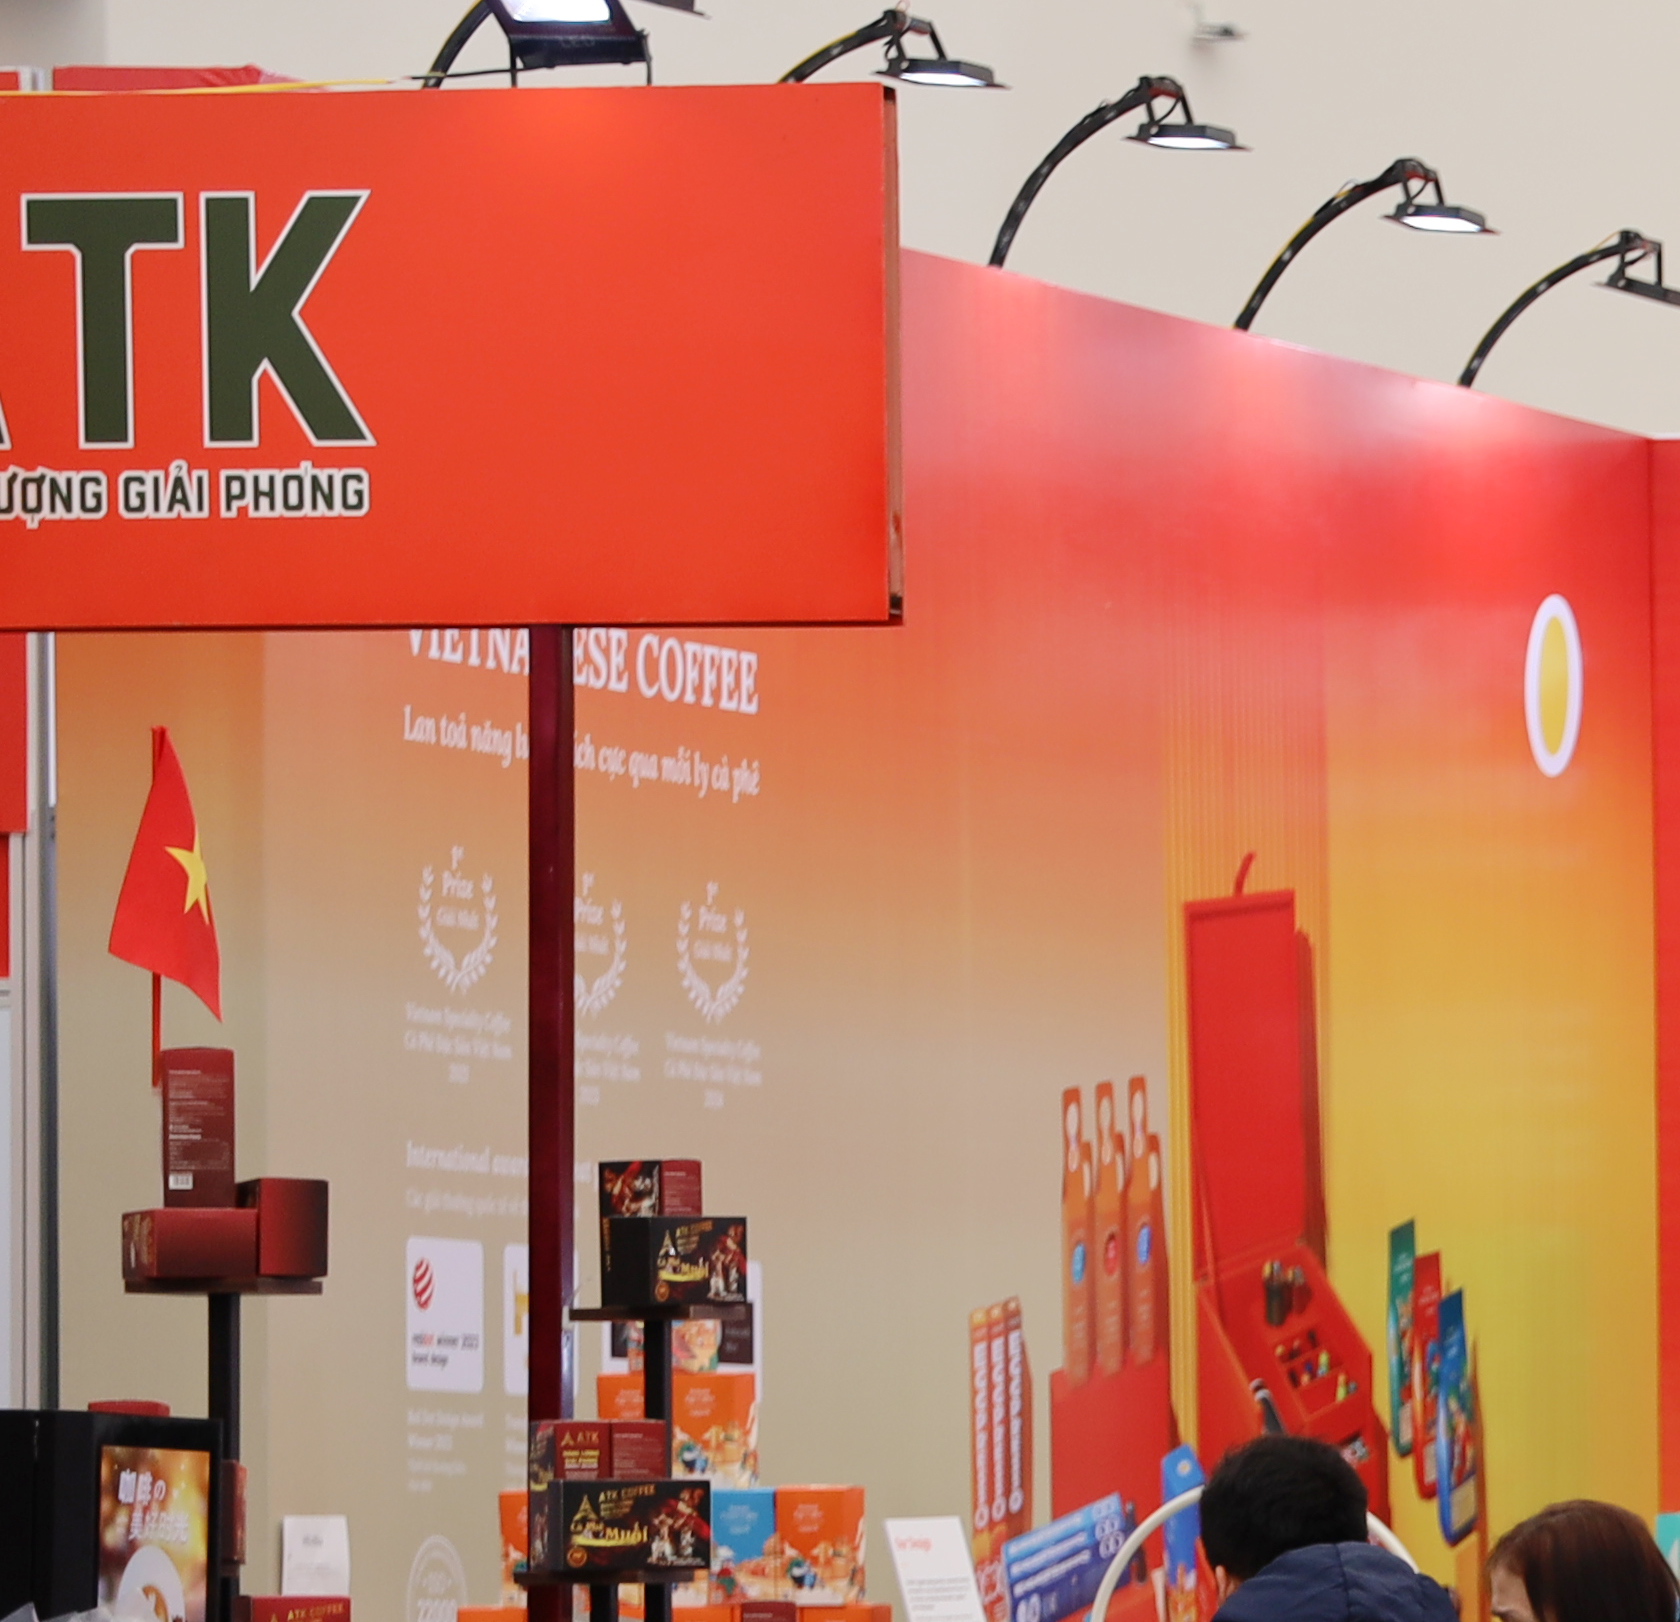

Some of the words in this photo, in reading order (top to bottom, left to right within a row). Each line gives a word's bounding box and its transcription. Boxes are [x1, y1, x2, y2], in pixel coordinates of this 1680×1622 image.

[0, 188, 376, 449] TK
[118, 459, 209, 518] GIẢI
[636, 634, 758, 714] COFFEE
